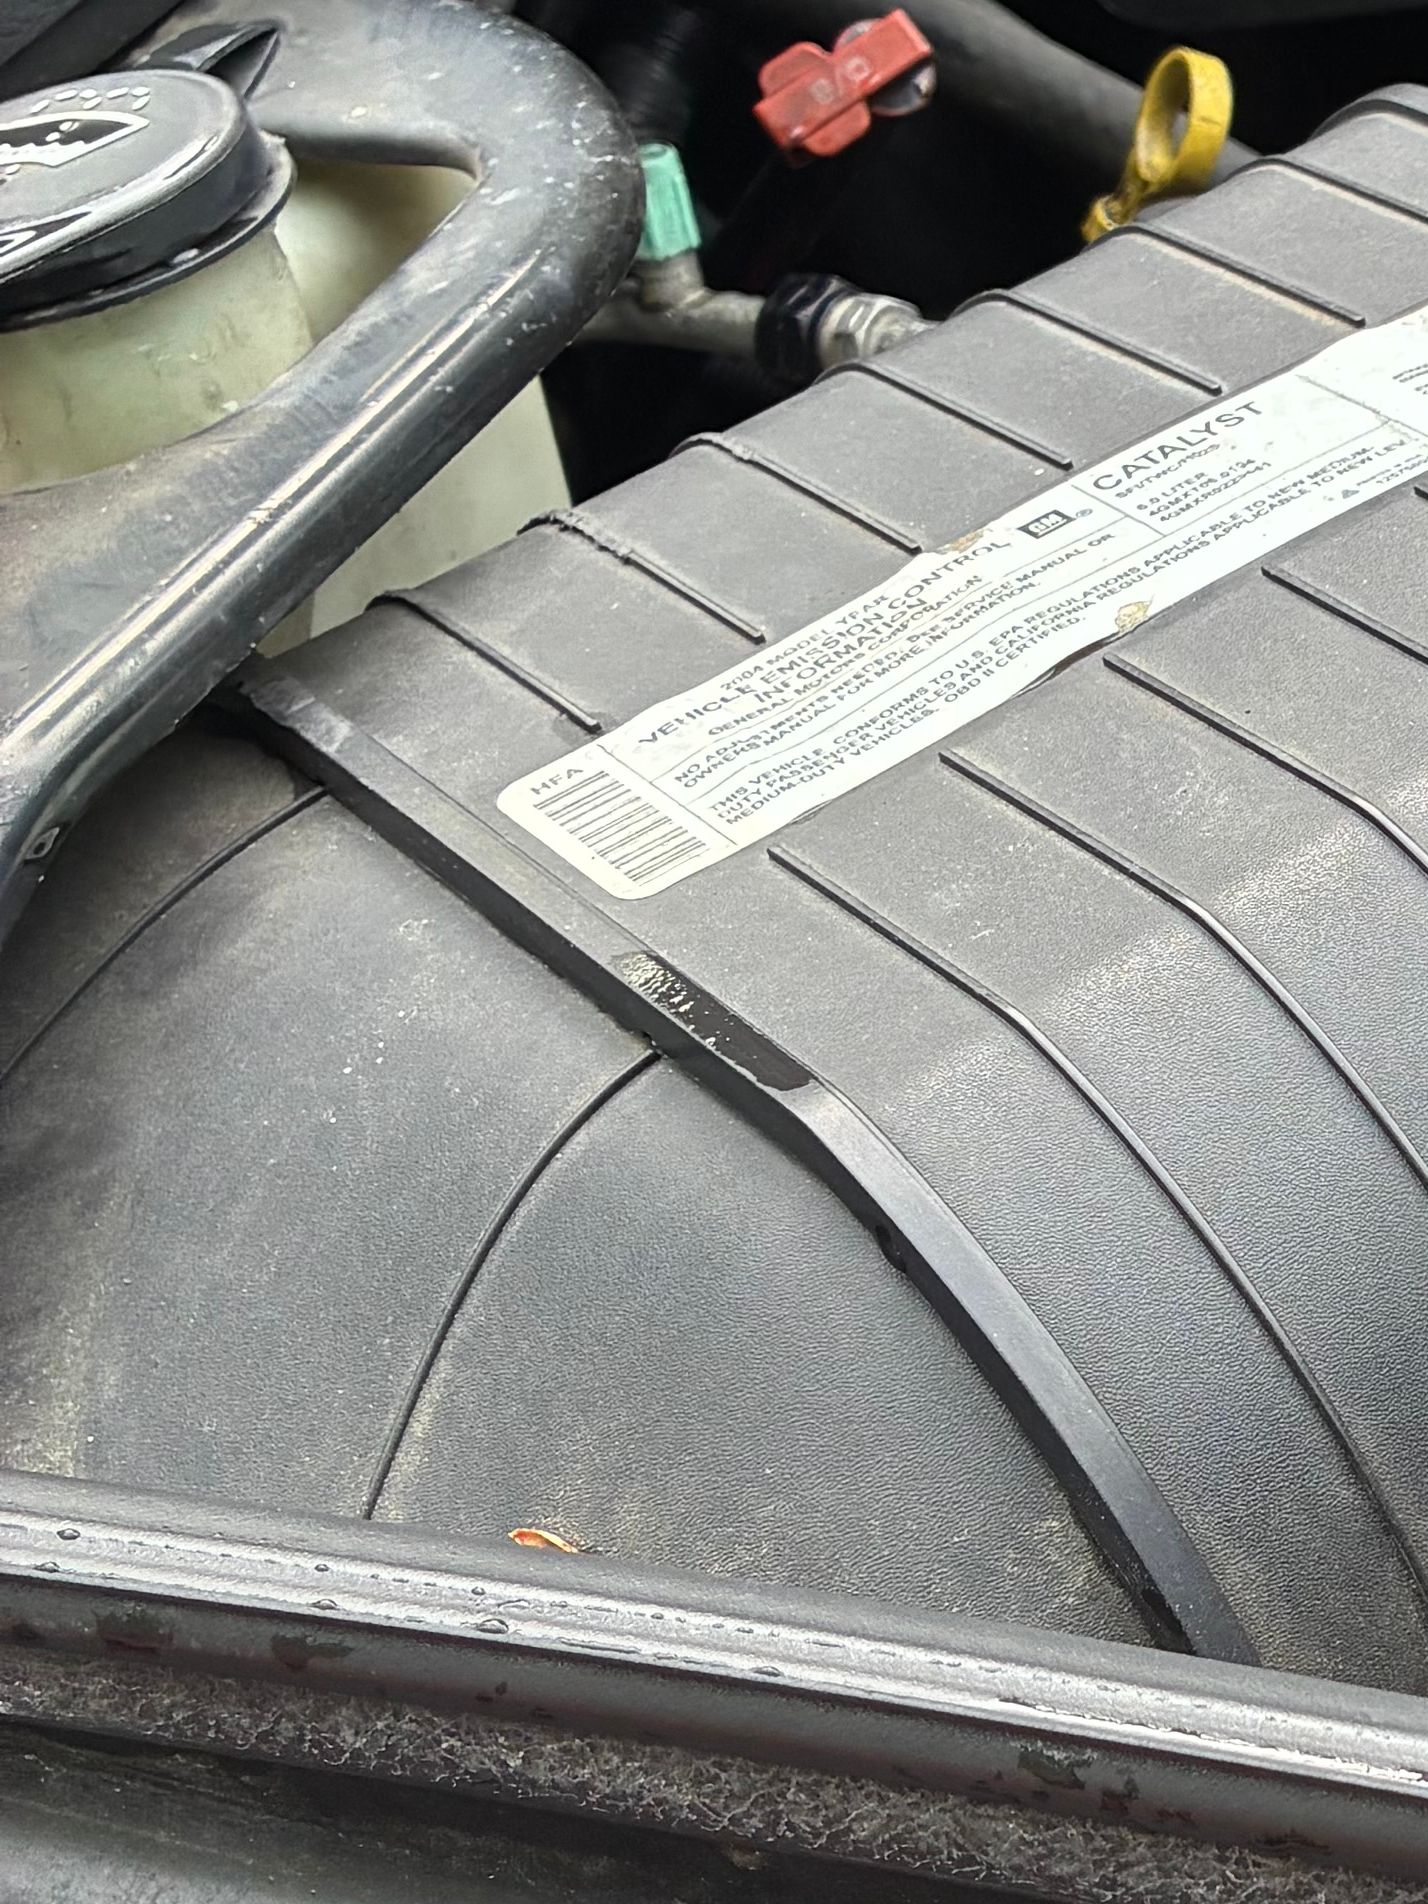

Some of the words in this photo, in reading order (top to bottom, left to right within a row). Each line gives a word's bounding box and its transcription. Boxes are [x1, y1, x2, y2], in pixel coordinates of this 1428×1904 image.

[1092, 400, 1262, 490] CATALYST
[1160, 471, 1208, 497] LITER
[637, 684, 757, 743] VEHICLE
[759, 612, 884, 684] EMISSION
[887, 542, 1011, 609] CONTROL
[674, 763, 700, 782] NO
[705, 695, 828, 763] ADJUSTMENTS
[940, 580, 1013, 623] SERVICE
[1015, 548, 1087, 582] MANUAL
[1087, 533, 1115, 546] OR
[707, 697, 793, 735] GENERAL
[793, 652, 865, 695] MOTORS
[867, 574, 982, 650] CORPORATION
[708, 786, 748, 810] THIS
[747, 747, 823, 784] VEHICLE
[832, 686, 929, 744] CONFORMS
[927, 669, 953, 684] TO
[988, 625, 1023, 646] EPA
[1023, 566, 1140, 624] REGULATIONS
[1143, 512, 1242, 567] APPLICABLE
[1242, 499, 1266, 511] TO
[1267, 478, 1305, 499] NEW
[717, 787, 761, 818] DUTY
[765, 732, 873, 788] PASSENGER
[874, 681, 956, 730] VEHICLES
[959, 655, 993, 681] AND
[994, 600, 1096, 654] CALIFORNIA
[1095, 540, 1210, 600] REGULATIONS
[1213, 487, 1311, 541] APPLICABLE
[1310, 475, 1334, 486] TO
[1335, 455, 1373, 475] NEW
[1374, 438, 1406, 456] LEV
[720, 665, 764, 690] 2004
[765, 628, 830, 665] MODEL
[835, 594, 889, 624] YEAR
[753, 597, 927, 703] INFORMATION
[725, 755, 845, 824] MEDIUM-DUTY
[943, 677, 981, 702] OBD
[762, 703, 836, 746] MANUAL
[836, 677, 874, 701] FOR
[873, 644, 925, 677] MORE
[530, 768, 583, 795] HFA
